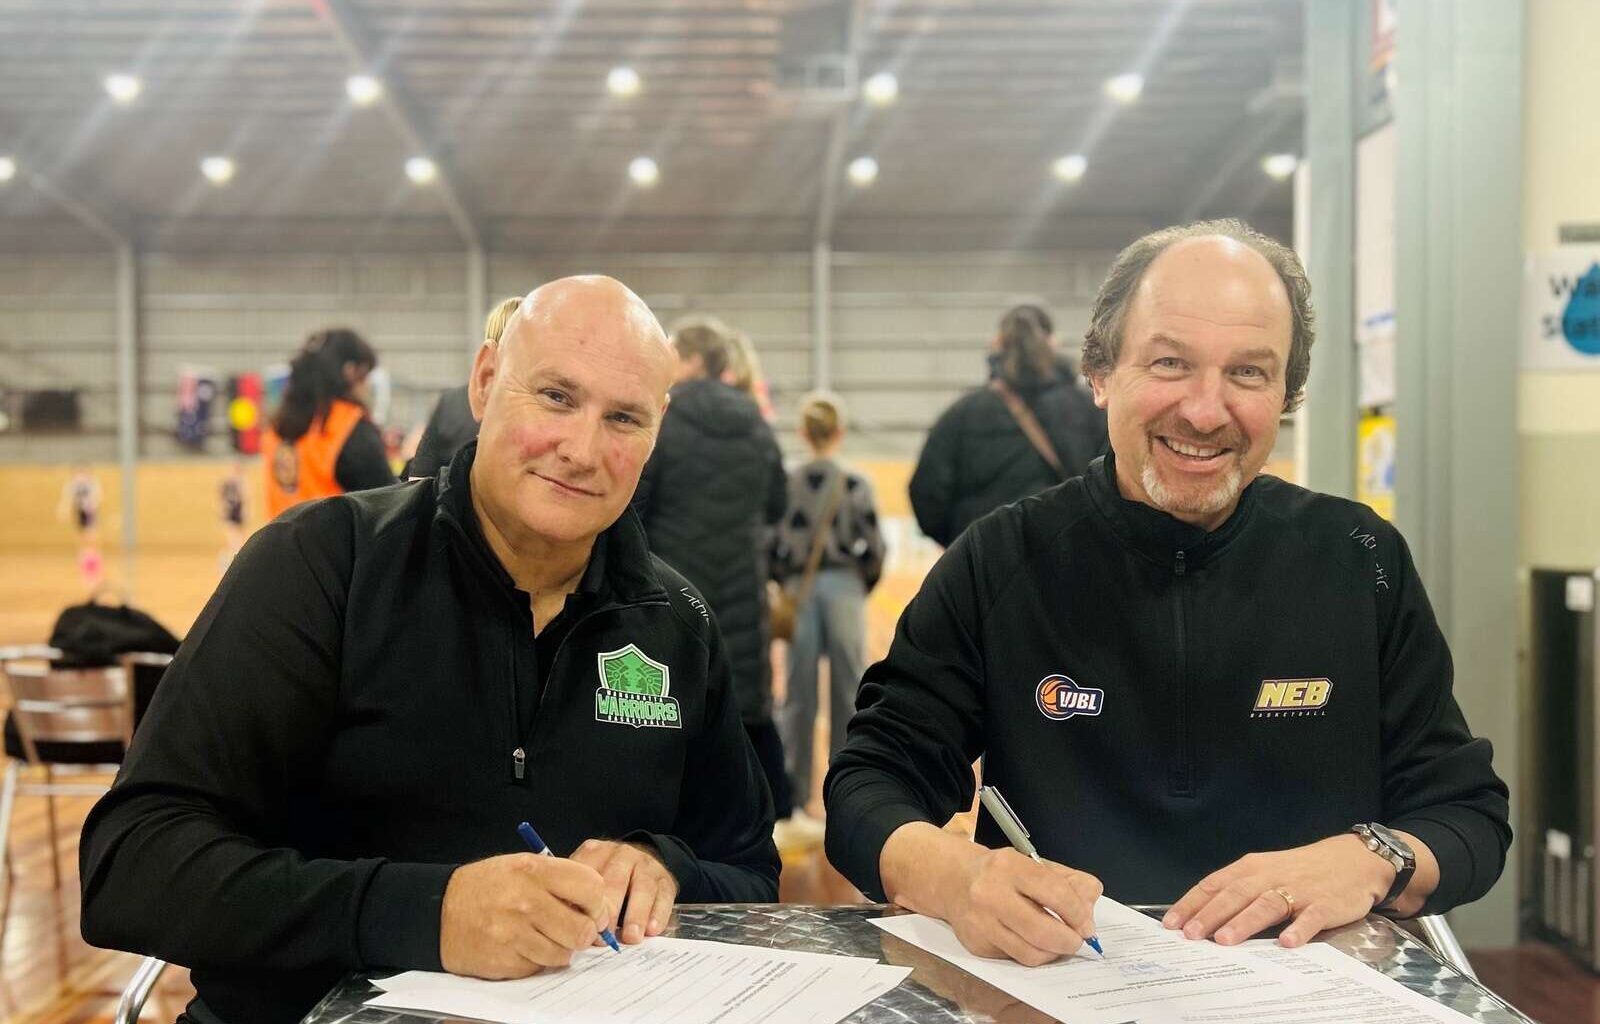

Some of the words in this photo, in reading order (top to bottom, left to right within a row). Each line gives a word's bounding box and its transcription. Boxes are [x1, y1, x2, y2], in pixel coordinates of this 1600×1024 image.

[597, 693, 678, 721] WARRIORS
[1060, 691, 1097, 710] VJBL
[1256, 680, 1331, 708] NEB
